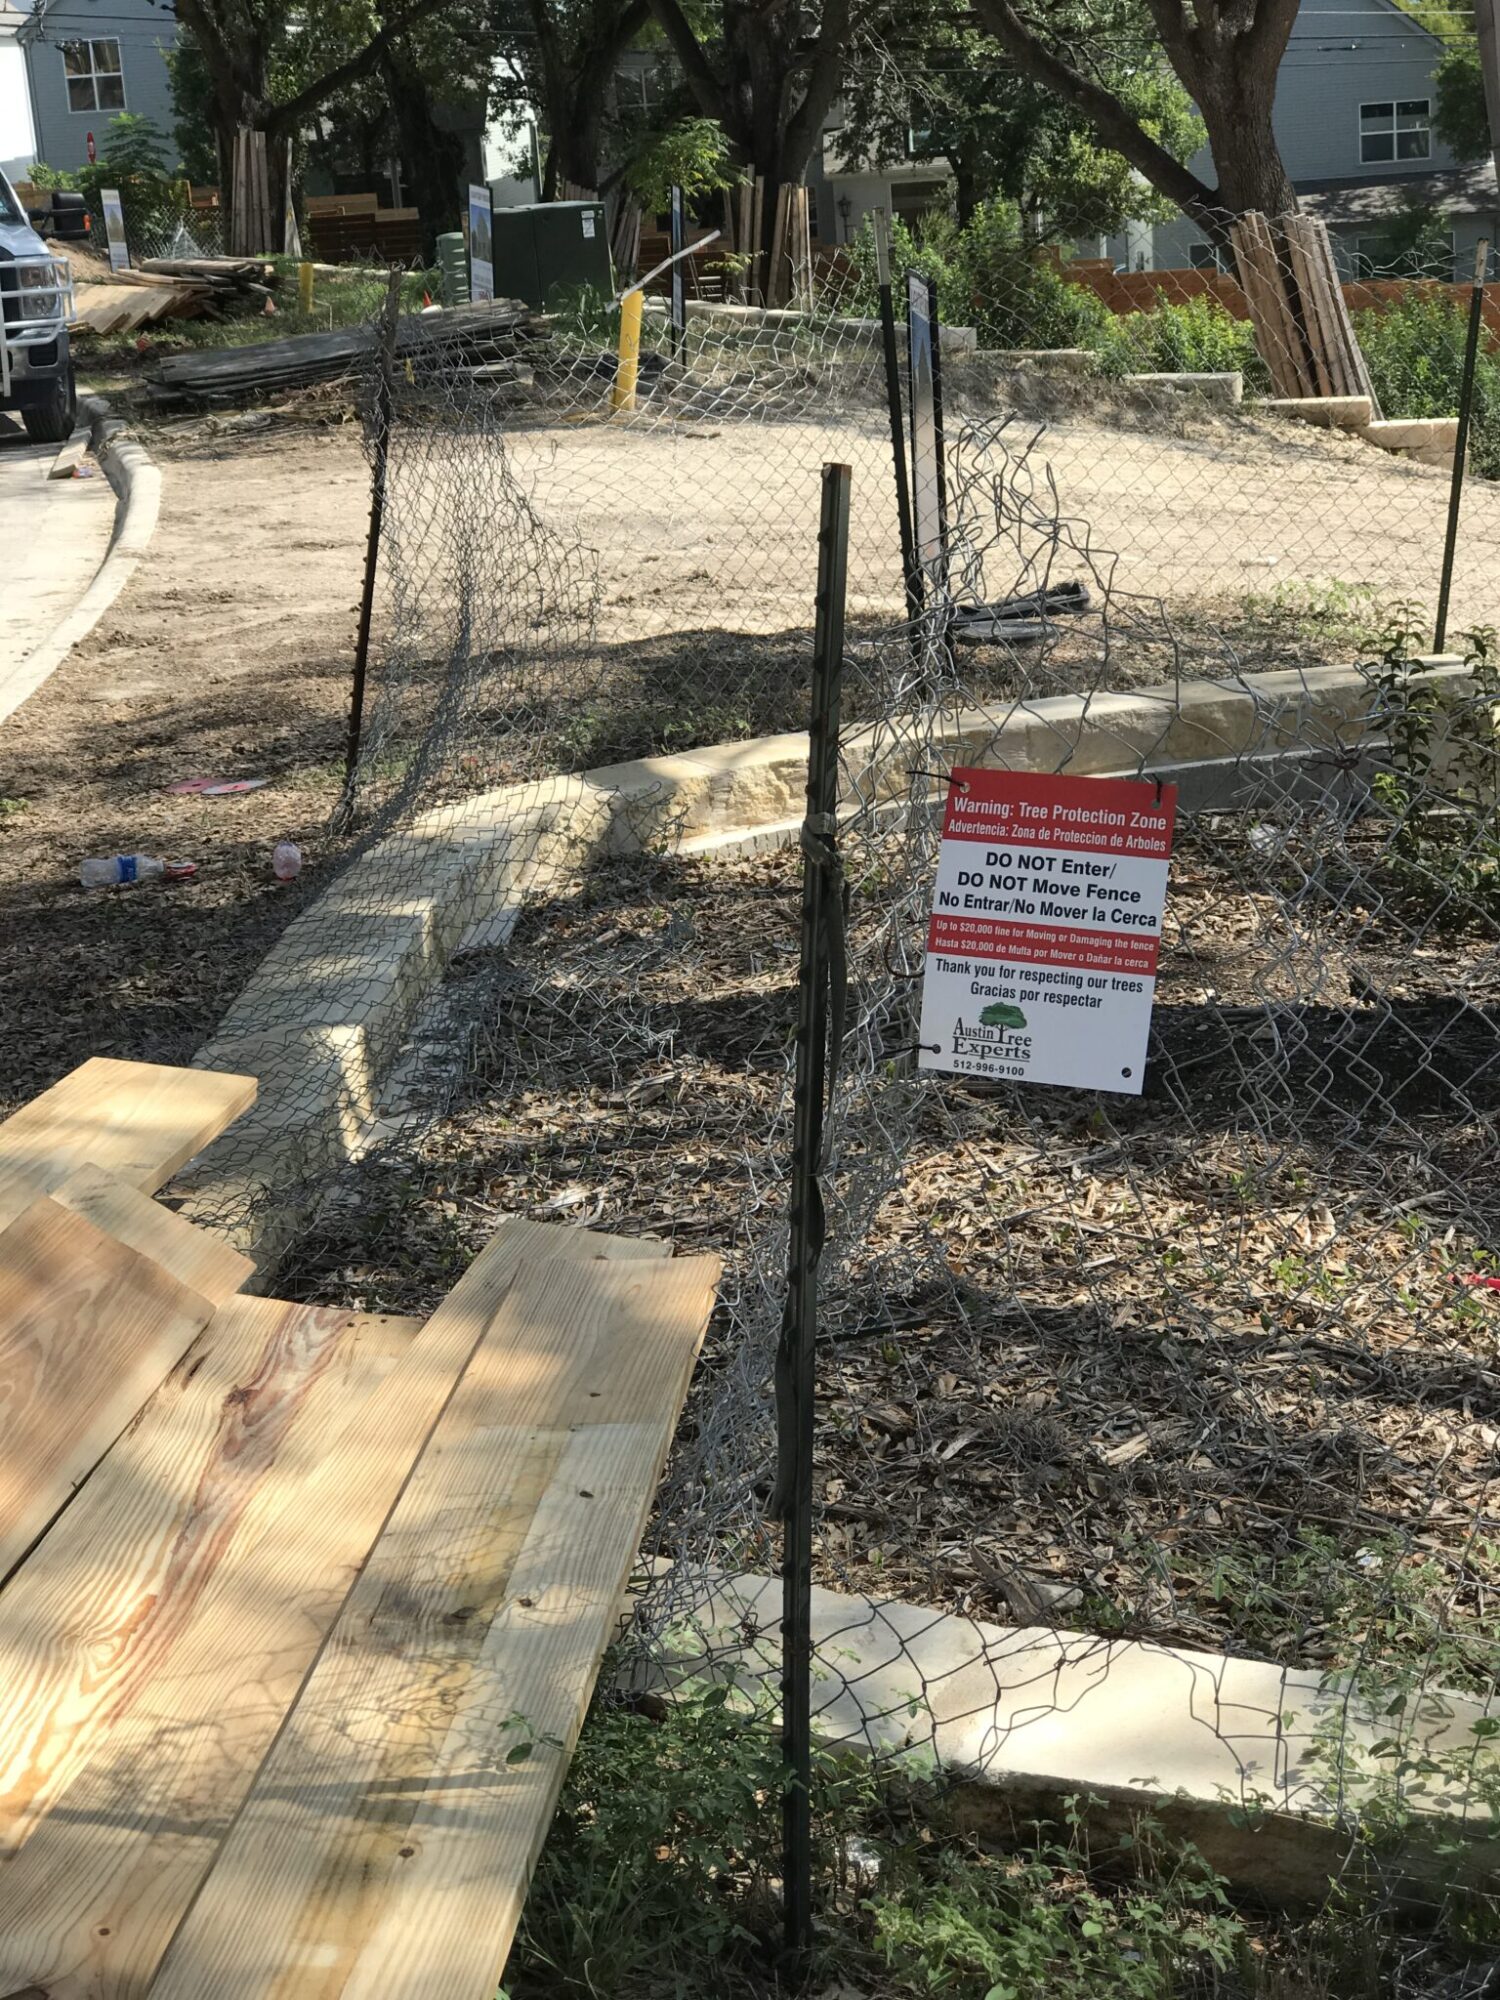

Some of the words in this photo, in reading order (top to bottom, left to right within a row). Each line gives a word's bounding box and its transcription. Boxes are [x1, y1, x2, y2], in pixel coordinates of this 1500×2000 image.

[954, 797, 1013, 819] Warning:
[1019, 802, 1048, 819] Tree
[1052, 805, 1125, 826] Protection
[1130, 812, 1167, 830] Zone
[948, 819, 1009, 837] Advertencia:
[1012, 824, 1035, 839] Zona
[1038, 826, 1050, 840] de
[1053, 828, 1107, 846] Proteccion
[1110, 834, 1123, 847] de
[1126, 835, 1166, 851] Arboles
[985, 852, 1013, 868] DO
[1018, 854, 1057, 872] NOT
[1062, 859, 1118, 879] Enter/
[957, 871, 984, 887] DO
[989, 874, 1027, 892] NOT
[1032, 878, 1081, 897] Move
[1086, 883, 1141, 903] Fence
[939, 891, 959, 908] No
[963, 894, 1035, 915] Entrar/No
[1039, 901, 1088, 920] Mover
[1092, 906, 1106, 922] la
[1111, 908, 1157, 927] Cerca
[936, 919, 948, 931] Up
[950, 921, 958, 931] to
[960, 922, 993, 935] $20,000
[995, 925, 1011, 937] fine
[1012, 927, 1024, 938] for
[1026, 929, 1057, 943] Moving
[1058, 934, 1068, 942] or
[1070, 933, 1113, 949] Damaging
[1115, 938, 1128, 949] the
[1130, 940, 1155, 951] fence
[935, 937, 959, 949] Hasta
[961, 939, 994, 952] $20,000
[996, 943, 1007, 953] de
[1008, 944, 1032, 956] Multa
[1034, 949, 1048, 959] por
[1050, 948, 1077, 960] Mover
[1114, 955, 1122, 966] la
[1124, 958, 1149, 969] cerca
[936, 958, 971, 975] Thank
[974, 965, 996, 978] you
[999, 965, 1016, 979] for
[1019, 968, 1083, 989] respecting
[1087, 975, 1108, 989] our
[1111, 976, 1144, 993] trees
[970, 981, 1016, 999] Gracias
[1020, 989, 1040, 1002] por
[1043, 990, 1103, 1008] respectar
[951, 1036, 1031, 1060] Experts
[953, 1017, 994, 1039] Austin
[998, 1024, 1032, 1047] Tree
[953, 1059, 1025, 1076] 512-996-9100
